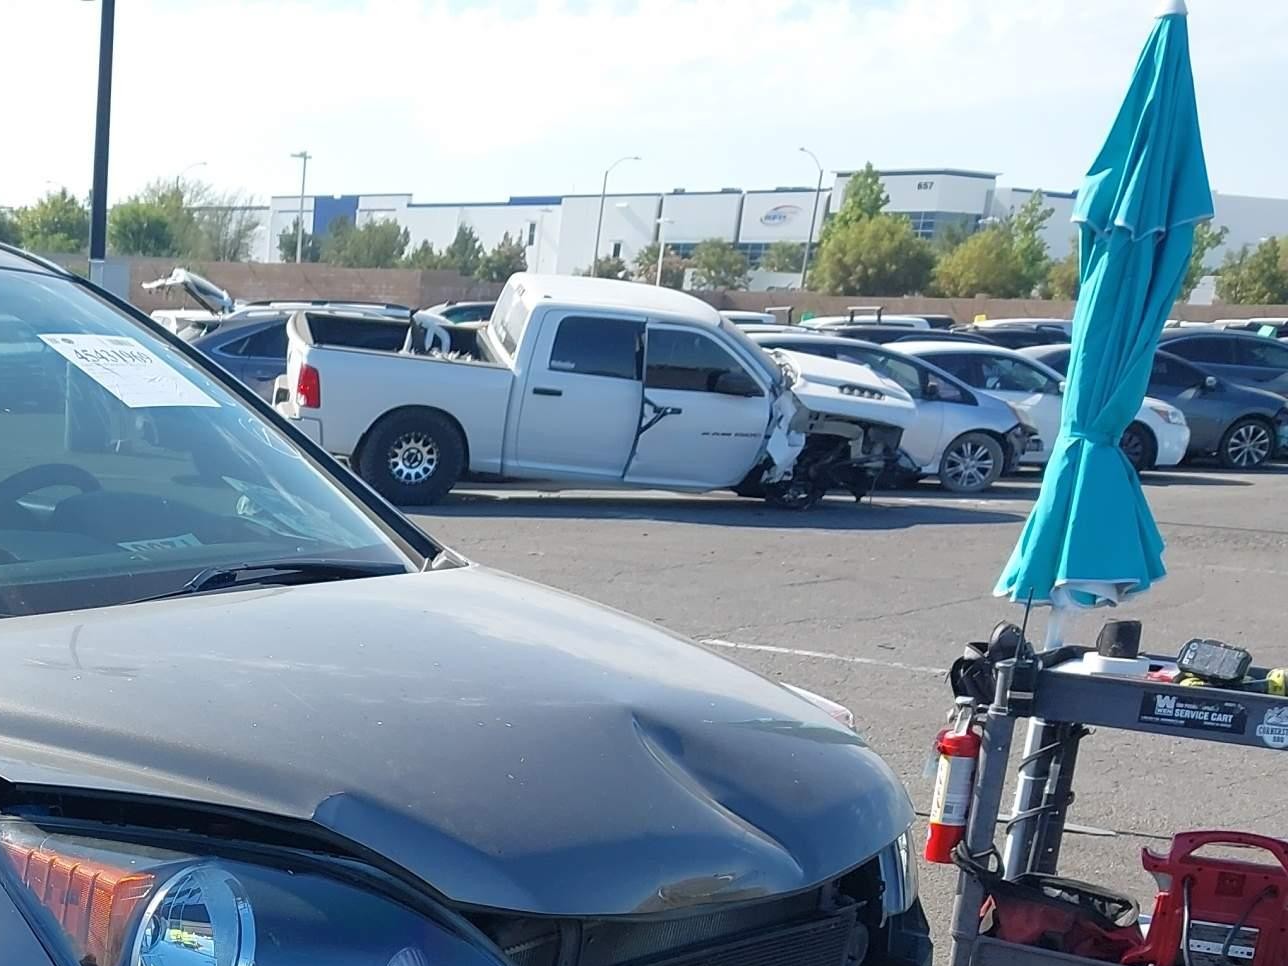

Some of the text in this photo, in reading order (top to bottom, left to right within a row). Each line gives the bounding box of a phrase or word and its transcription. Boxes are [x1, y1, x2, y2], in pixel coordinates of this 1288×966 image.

[74, 348, 153, 364] 45431969
[1175, 708, 1210, 721] SERVICE
[1210, 712, 1234, 723] CART
